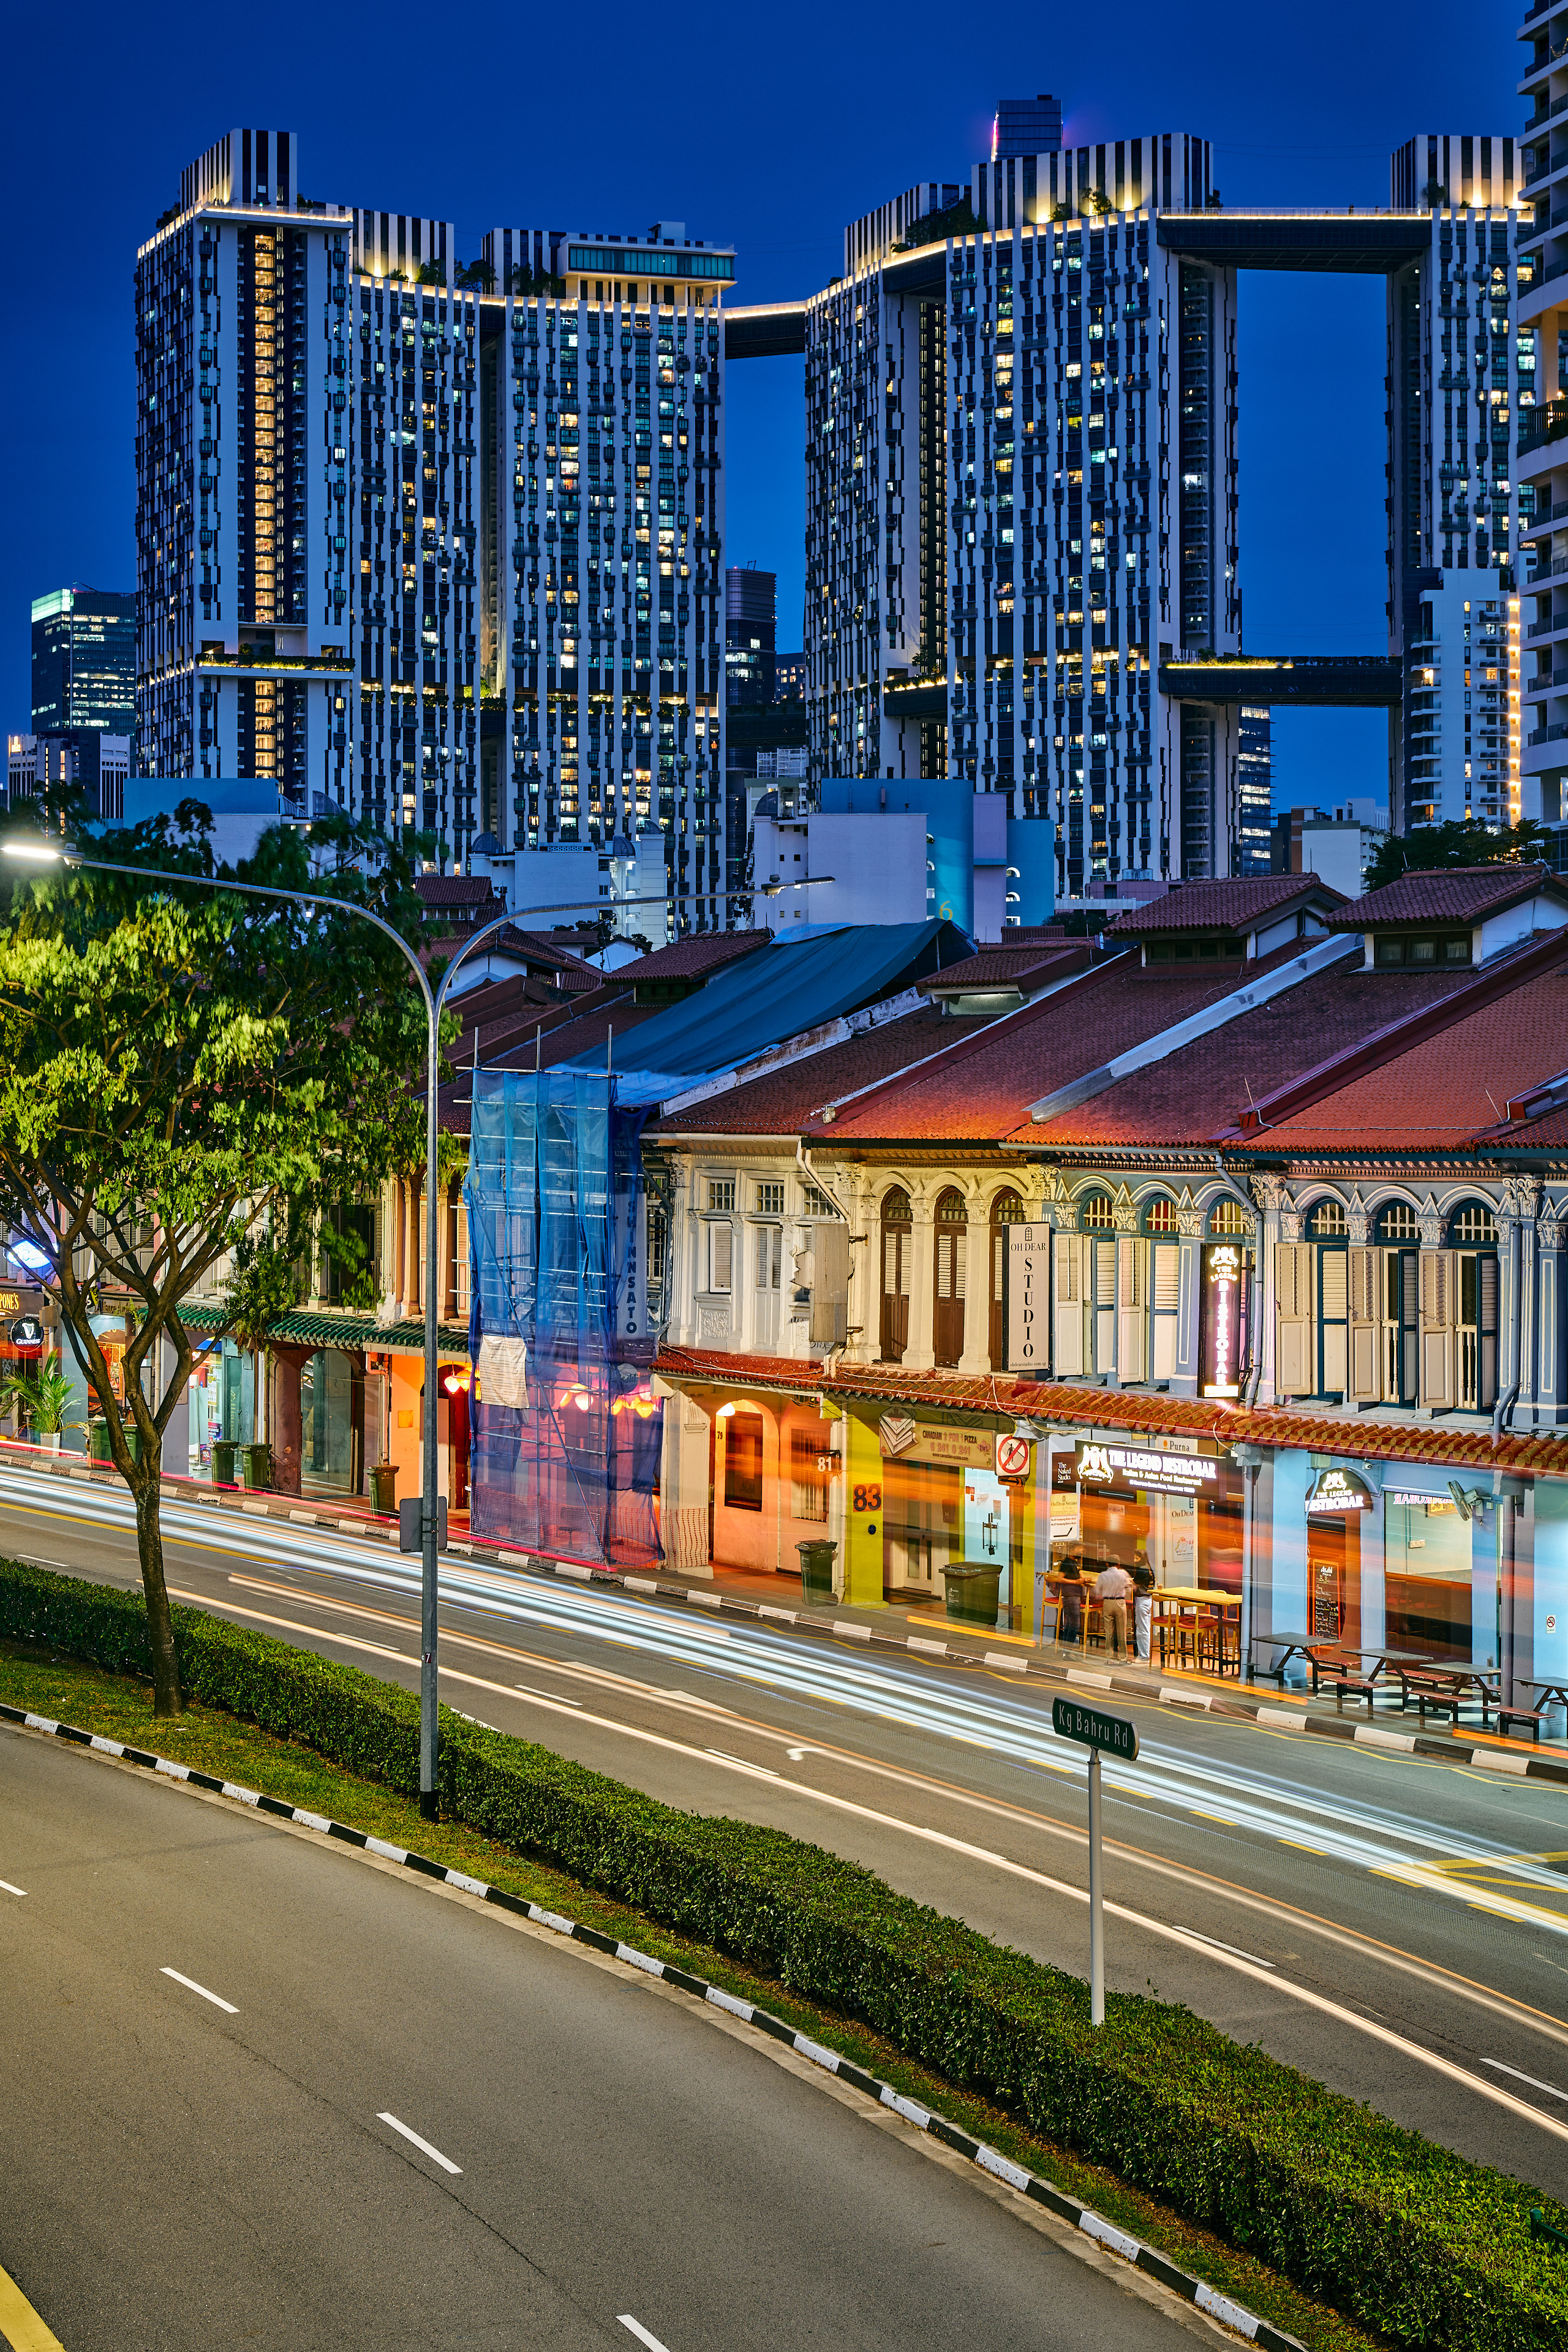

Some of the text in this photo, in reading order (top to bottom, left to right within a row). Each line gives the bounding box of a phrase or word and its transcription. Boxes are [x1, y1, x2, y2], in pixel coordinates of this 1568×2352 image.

[939, 900, 953, 920] 6
[1011, 1242, 1046, 1252] OH DEAR
[626, 1200, 637, 1334] SHINNSATO
[1210, 1272, 1238, 1283] LEGEND
[1023, 1257, 1034, 1358] STUDIO
[1215, 1280, 1229, 1385] BISTROBAR
[717, 1431, 723, 1440] 79
[922, 1430, 978, 1445] CANADIAN 2 FOR 1 PIZZA
[930, 1442, 935, 1452] 6
[937, 1442, 949, 1453] 241
[959, 1446, 971, 1456] 241
[1169, 1441, 1190, 1452] Purna
[817, 1457, 832, 1472] 81
[1108, 1449, 1217, 1479] THE LEGEND BISTROBAR
[1159, 1473, 1173, 1482] Food
[1173, 1475, 1202, 1487] Restaurant
[853, 1484, 882, 1512] 83
[1059, 1704, 1128, 1748] Kg Bahru Rd
